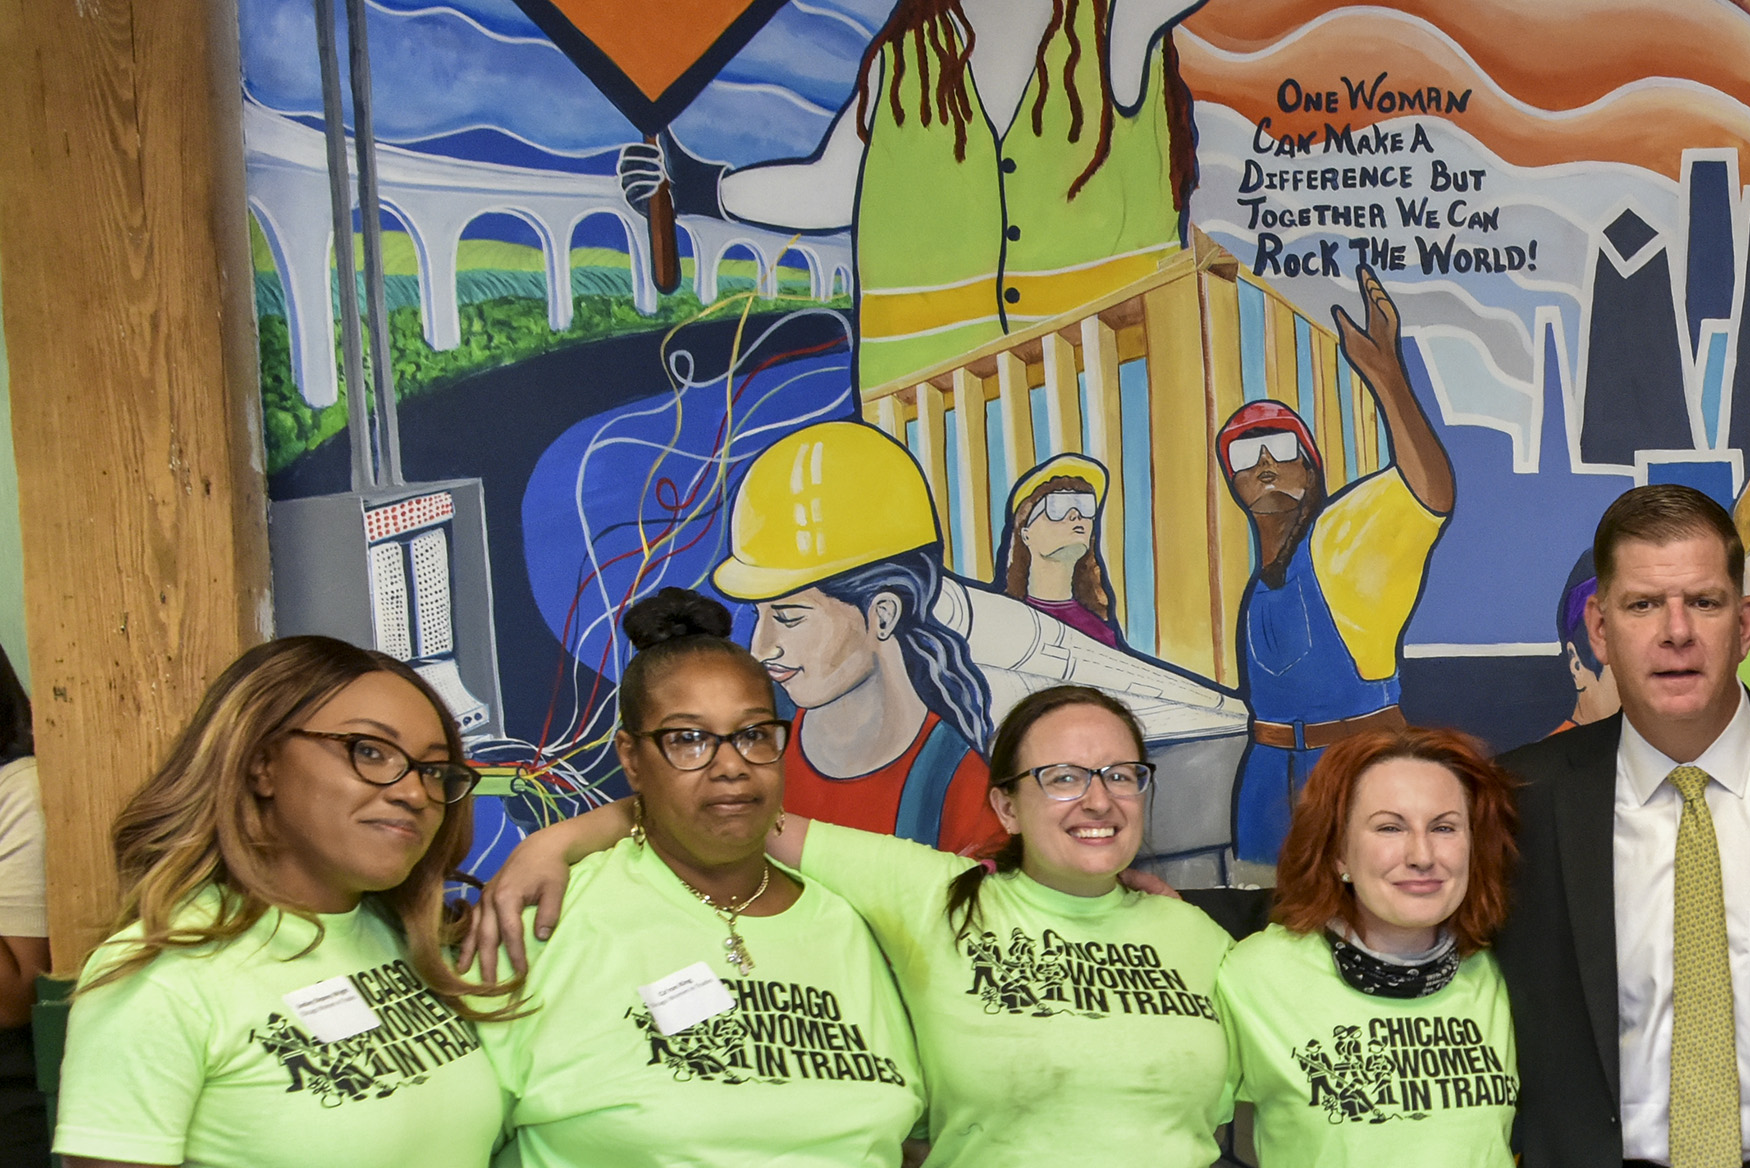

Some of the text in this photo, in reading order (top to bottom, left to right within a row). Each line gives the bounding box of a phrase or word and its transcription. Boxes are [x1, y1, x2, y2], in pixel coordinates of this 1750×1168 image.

[1410, 123, 1434, 153] A
[347, 959, 423, 1008] ICAGO
[1066, 960, 1188, 991] WOMEN
[1074, 986, 1110, 1013] IN
[742, 1012, 868, 1051] WOMEN
[1368, 1017, 1483, 1047] CHICAGO
[383, 1040, 428, 1078] IN
[754, 1044, 906, 1087] IN TRADES
[1392, 1045, 1504, 1079] WOMEN
[1400, 1079, 1432, 1111] IN
